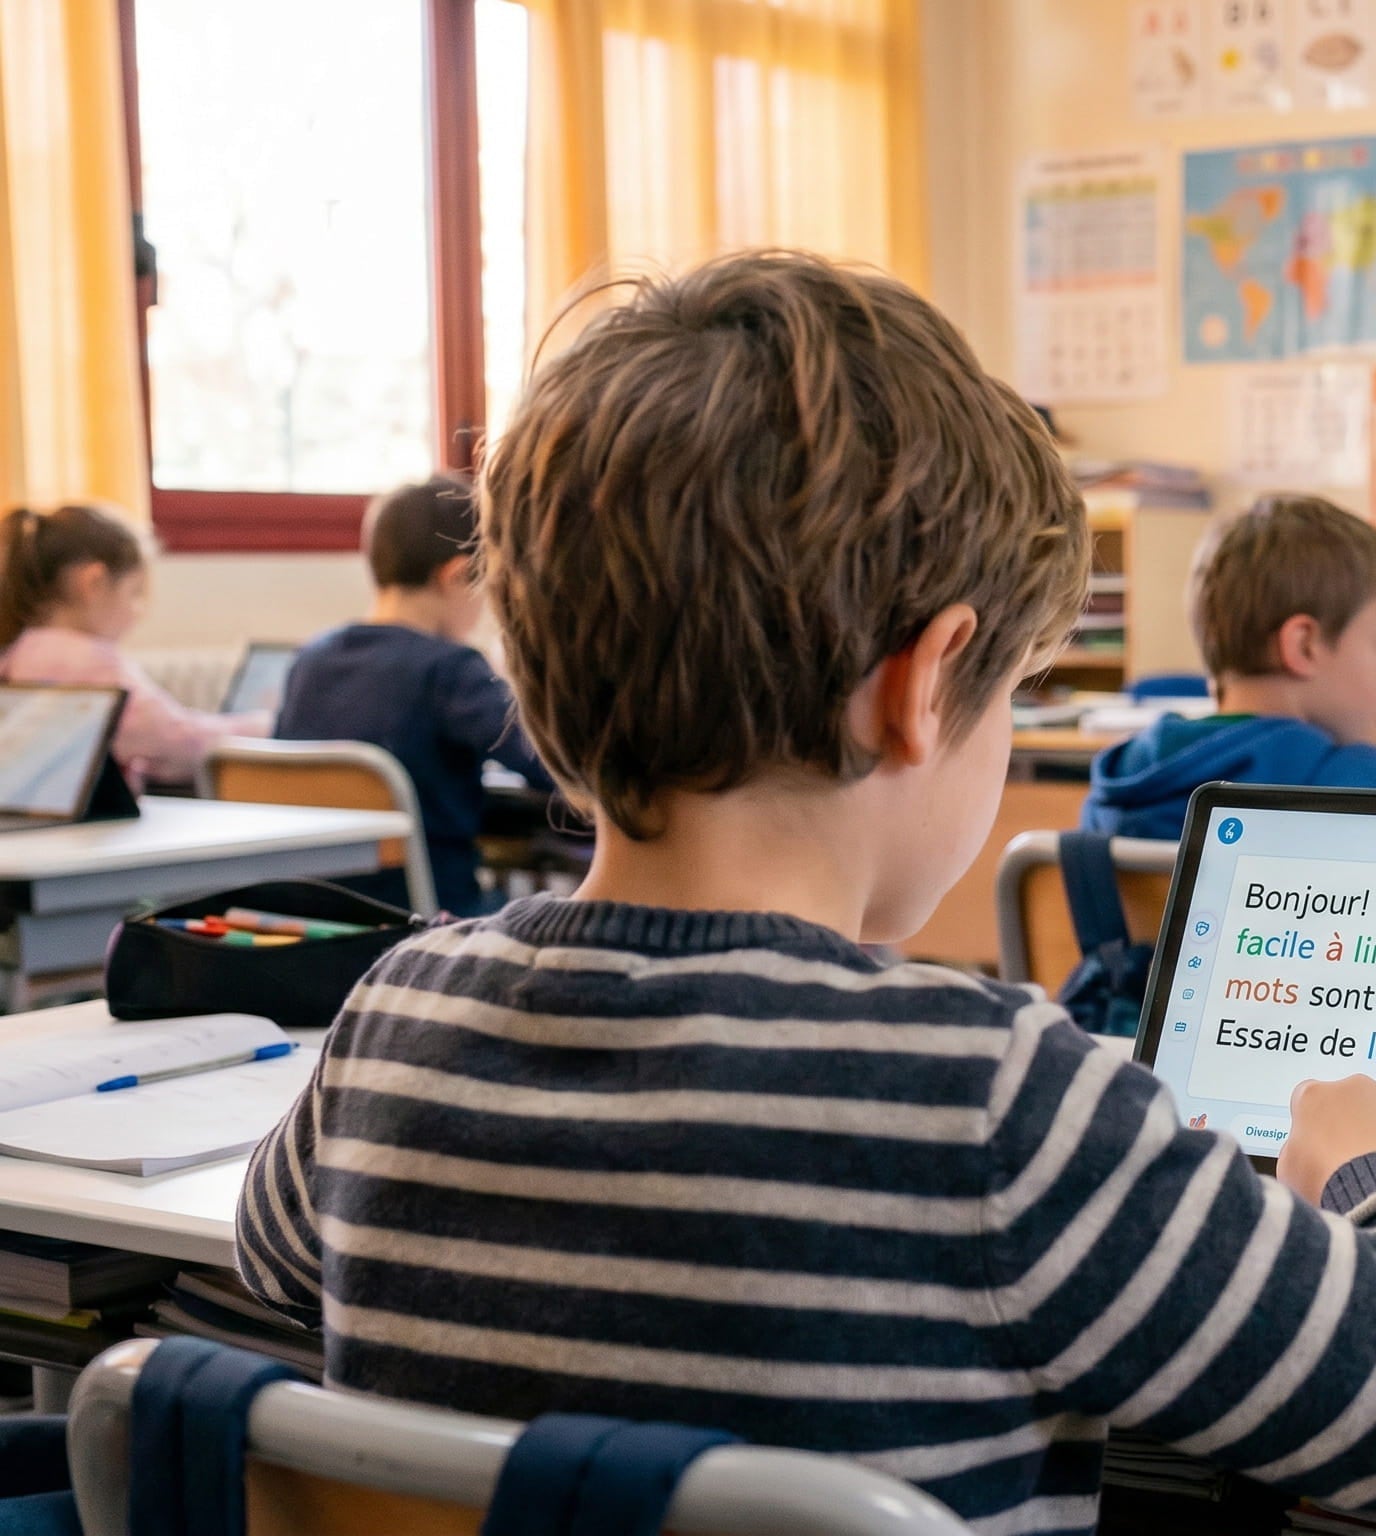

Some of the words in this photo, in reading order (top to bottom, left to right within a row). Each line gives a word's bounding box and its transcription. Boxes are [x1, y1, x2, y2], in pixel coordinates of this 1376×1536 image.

[1245, 883, 1370, 920] Bonjour!
[1236, 928, 1315, 959] facile
[1325, 932, 1344, 962] à
[1225, 978, 1299, 1004] mots
[1309, 986, 1375, 1011] sont
[1216, 1018, 1308, 1053] Essaie
[1320, 1028, 1356, 1057] de
